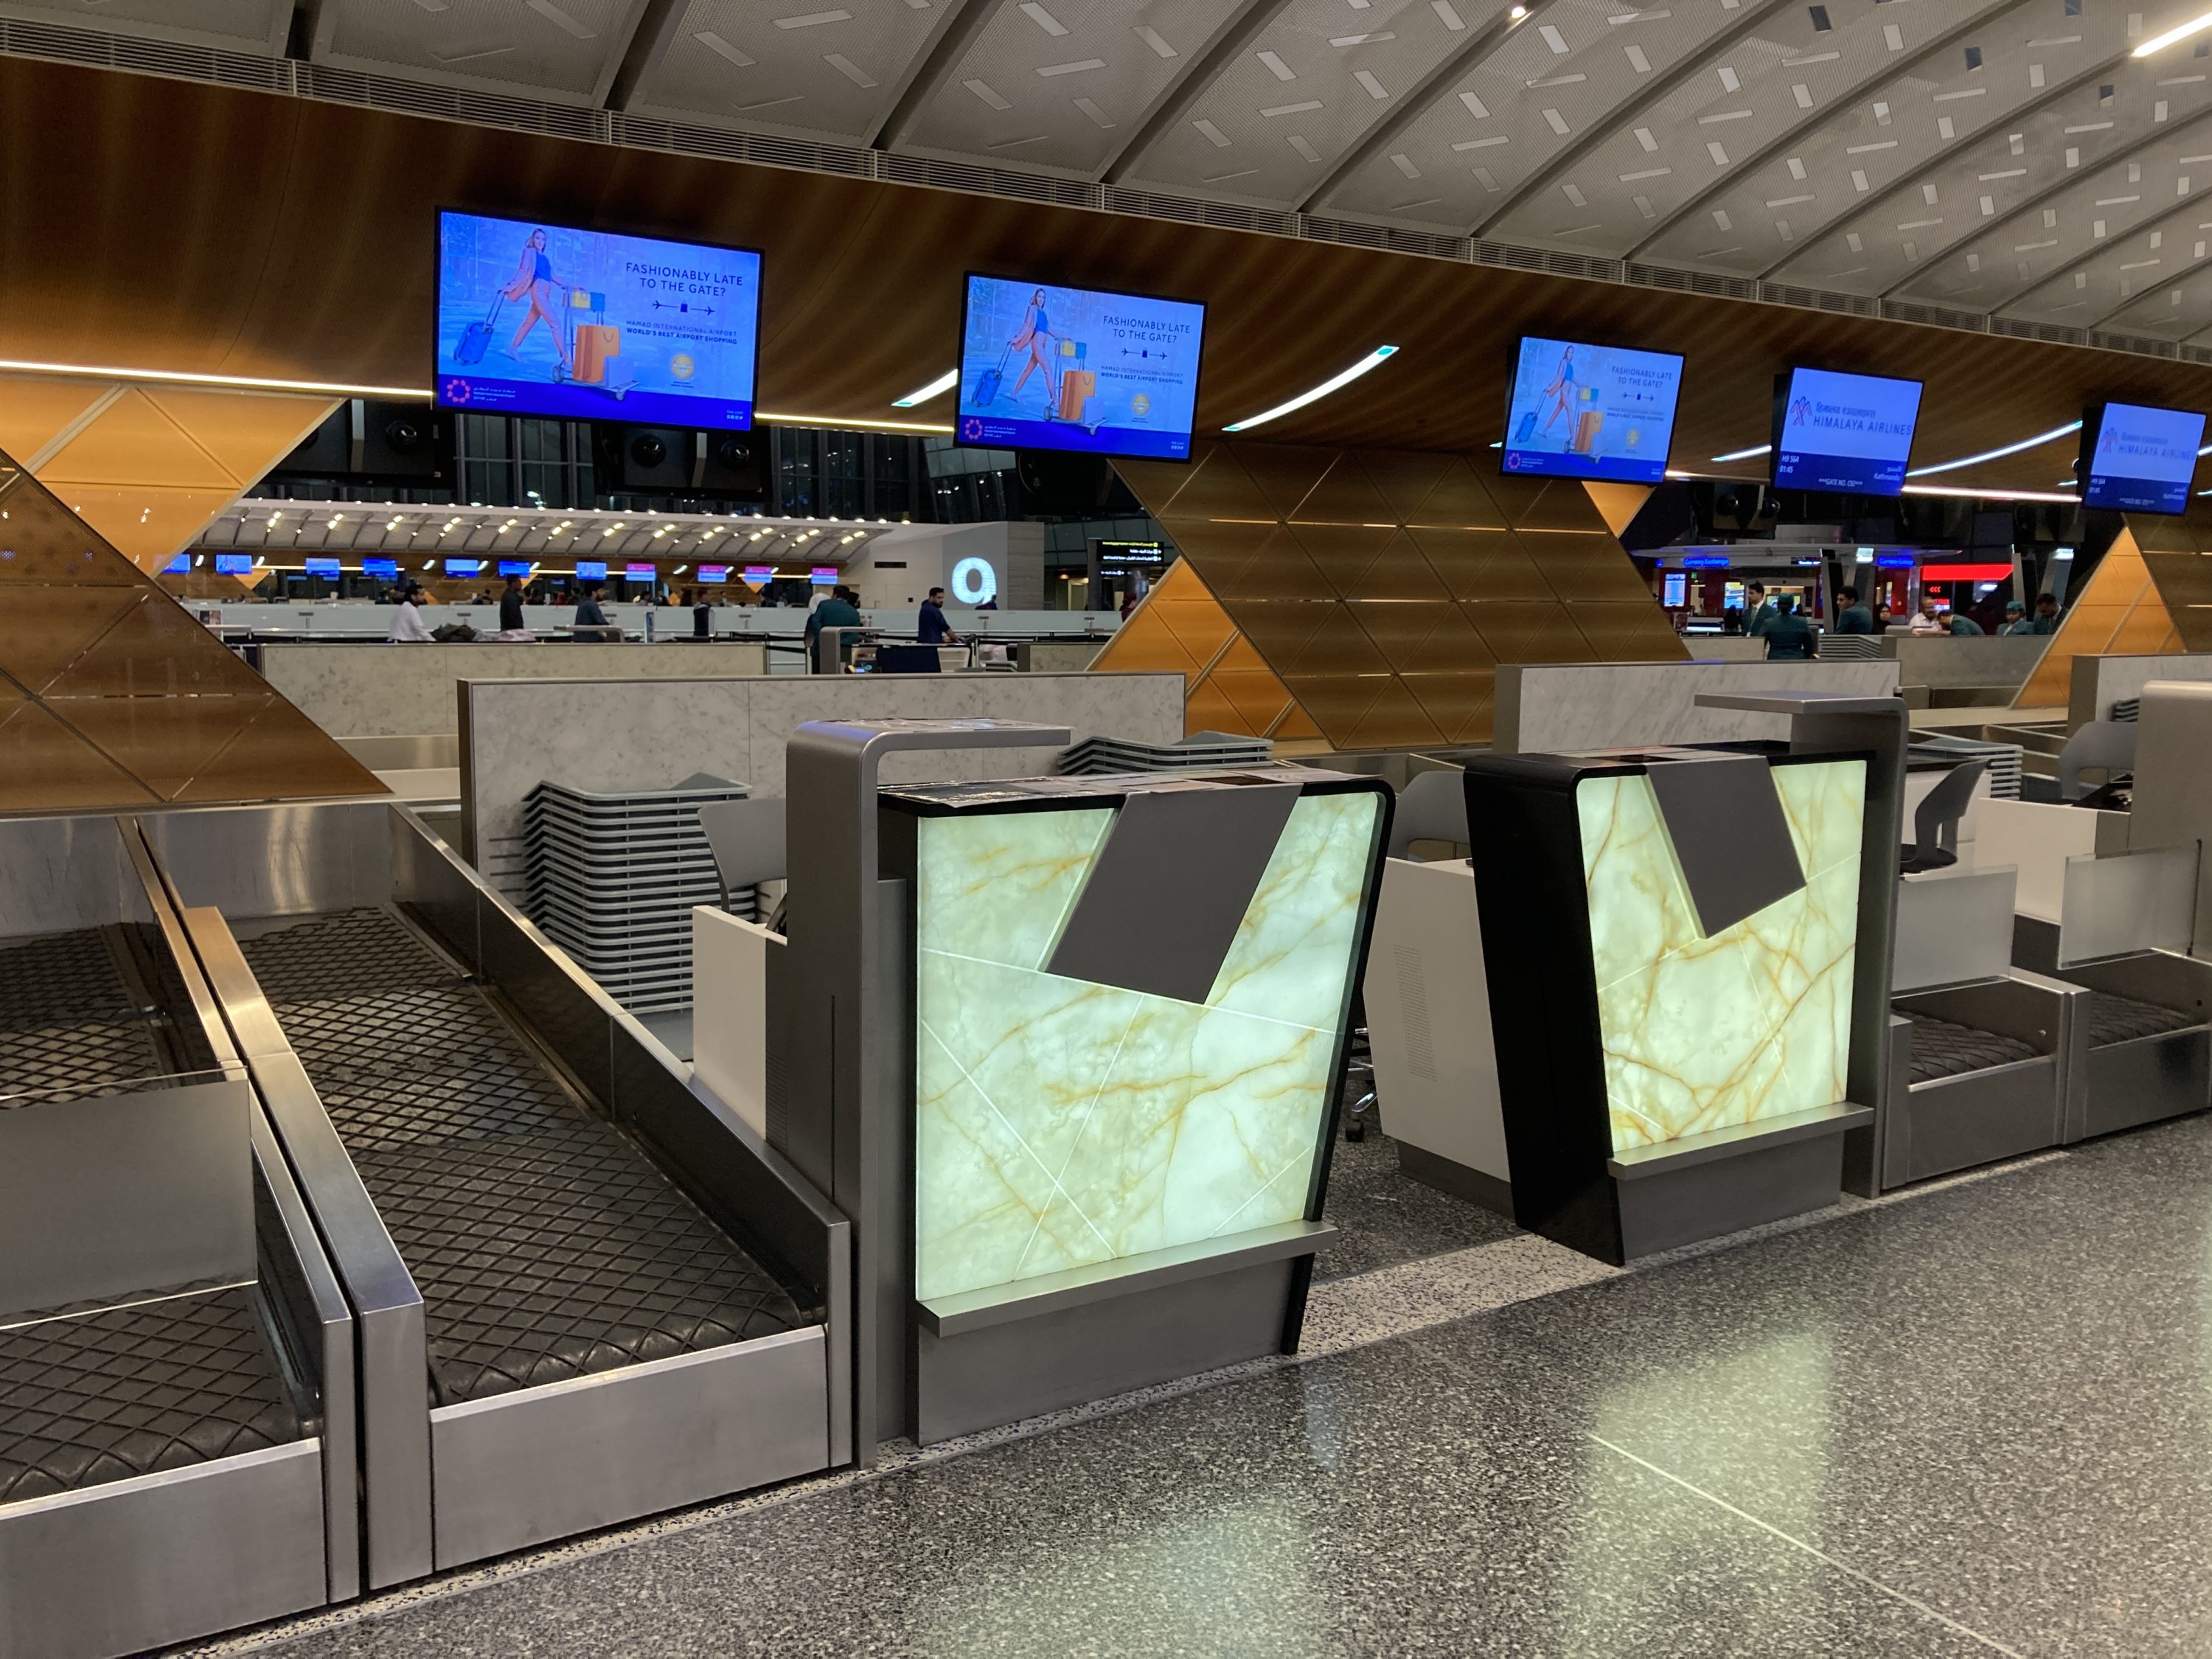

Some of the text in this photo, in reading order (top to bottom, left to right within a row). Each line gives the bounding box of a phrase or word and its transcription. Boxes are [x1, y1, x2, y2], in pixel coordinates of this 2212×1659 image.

[626, 262, 743, 286] FASHIONABLY LATE
[640, 277, 726, 296] TO THE GATE?
[626, 320, 737, 337] HAMAD INTERNATIONAL AIRPORT
[1103, 316, 1191, 333] FASHIONABLY LATE
[626, 327, 656, 336] WORLD'S
[676, 333, 703, 341] AIRPORT
[704, 336, 737, 345] SHOPPING
[1113, 329, 1178, 344] TO THE GATE?
[1121, 367, 1160, 376] INTERNATIONAL
[1611, 366, 1673, 380] FASHIONABLY LATE
[1618, 376, 1663, 389] TO THE GATE?
[1813, 415, 1912, 435] HIMALAYA AIRLINES
[2118, 444, 2157, 456] HIMALAYA
[1779, 465, 1794, 473] 01:45
